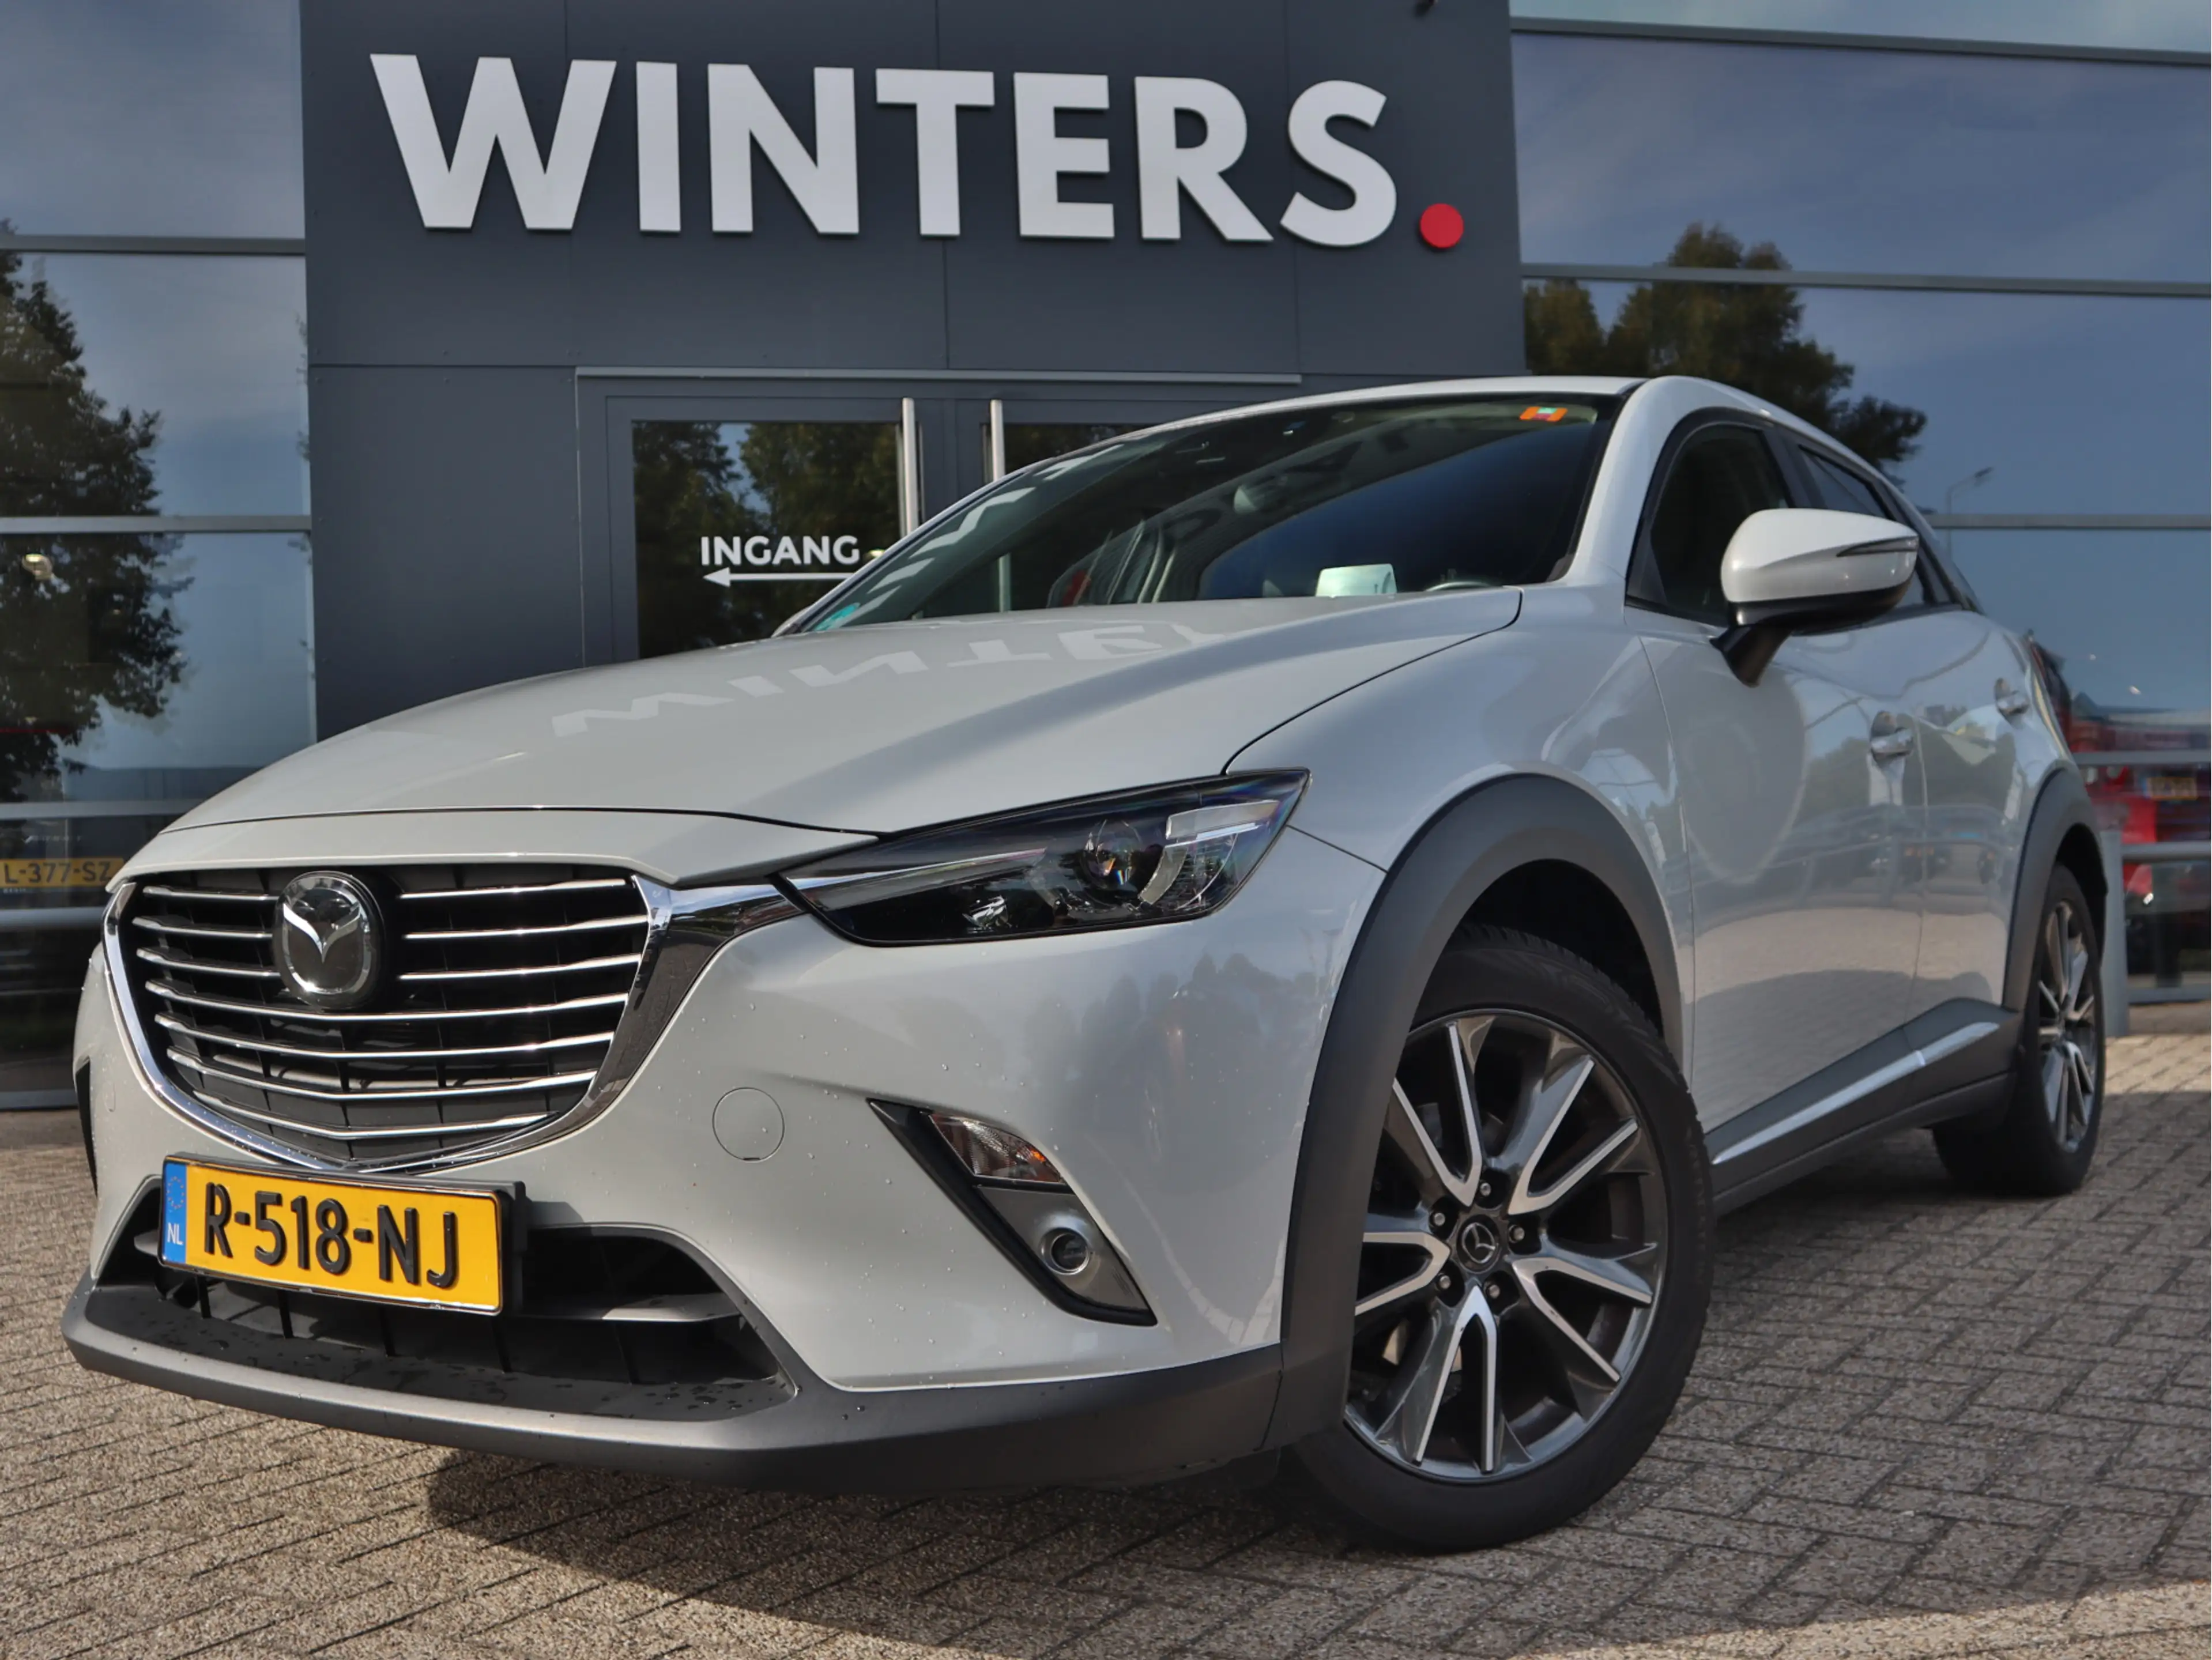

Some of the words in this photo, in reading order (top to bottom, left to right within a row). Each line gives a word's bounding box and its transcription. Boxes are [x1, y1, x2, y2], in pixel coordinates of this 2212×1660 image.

[701, 535, 860, 565] INGANG
[4, 862, 112, 884] L-377-SZ
[167, 1222, 183, 1245] NL
[204, 1182, 458, 1288] R-518-NJ
